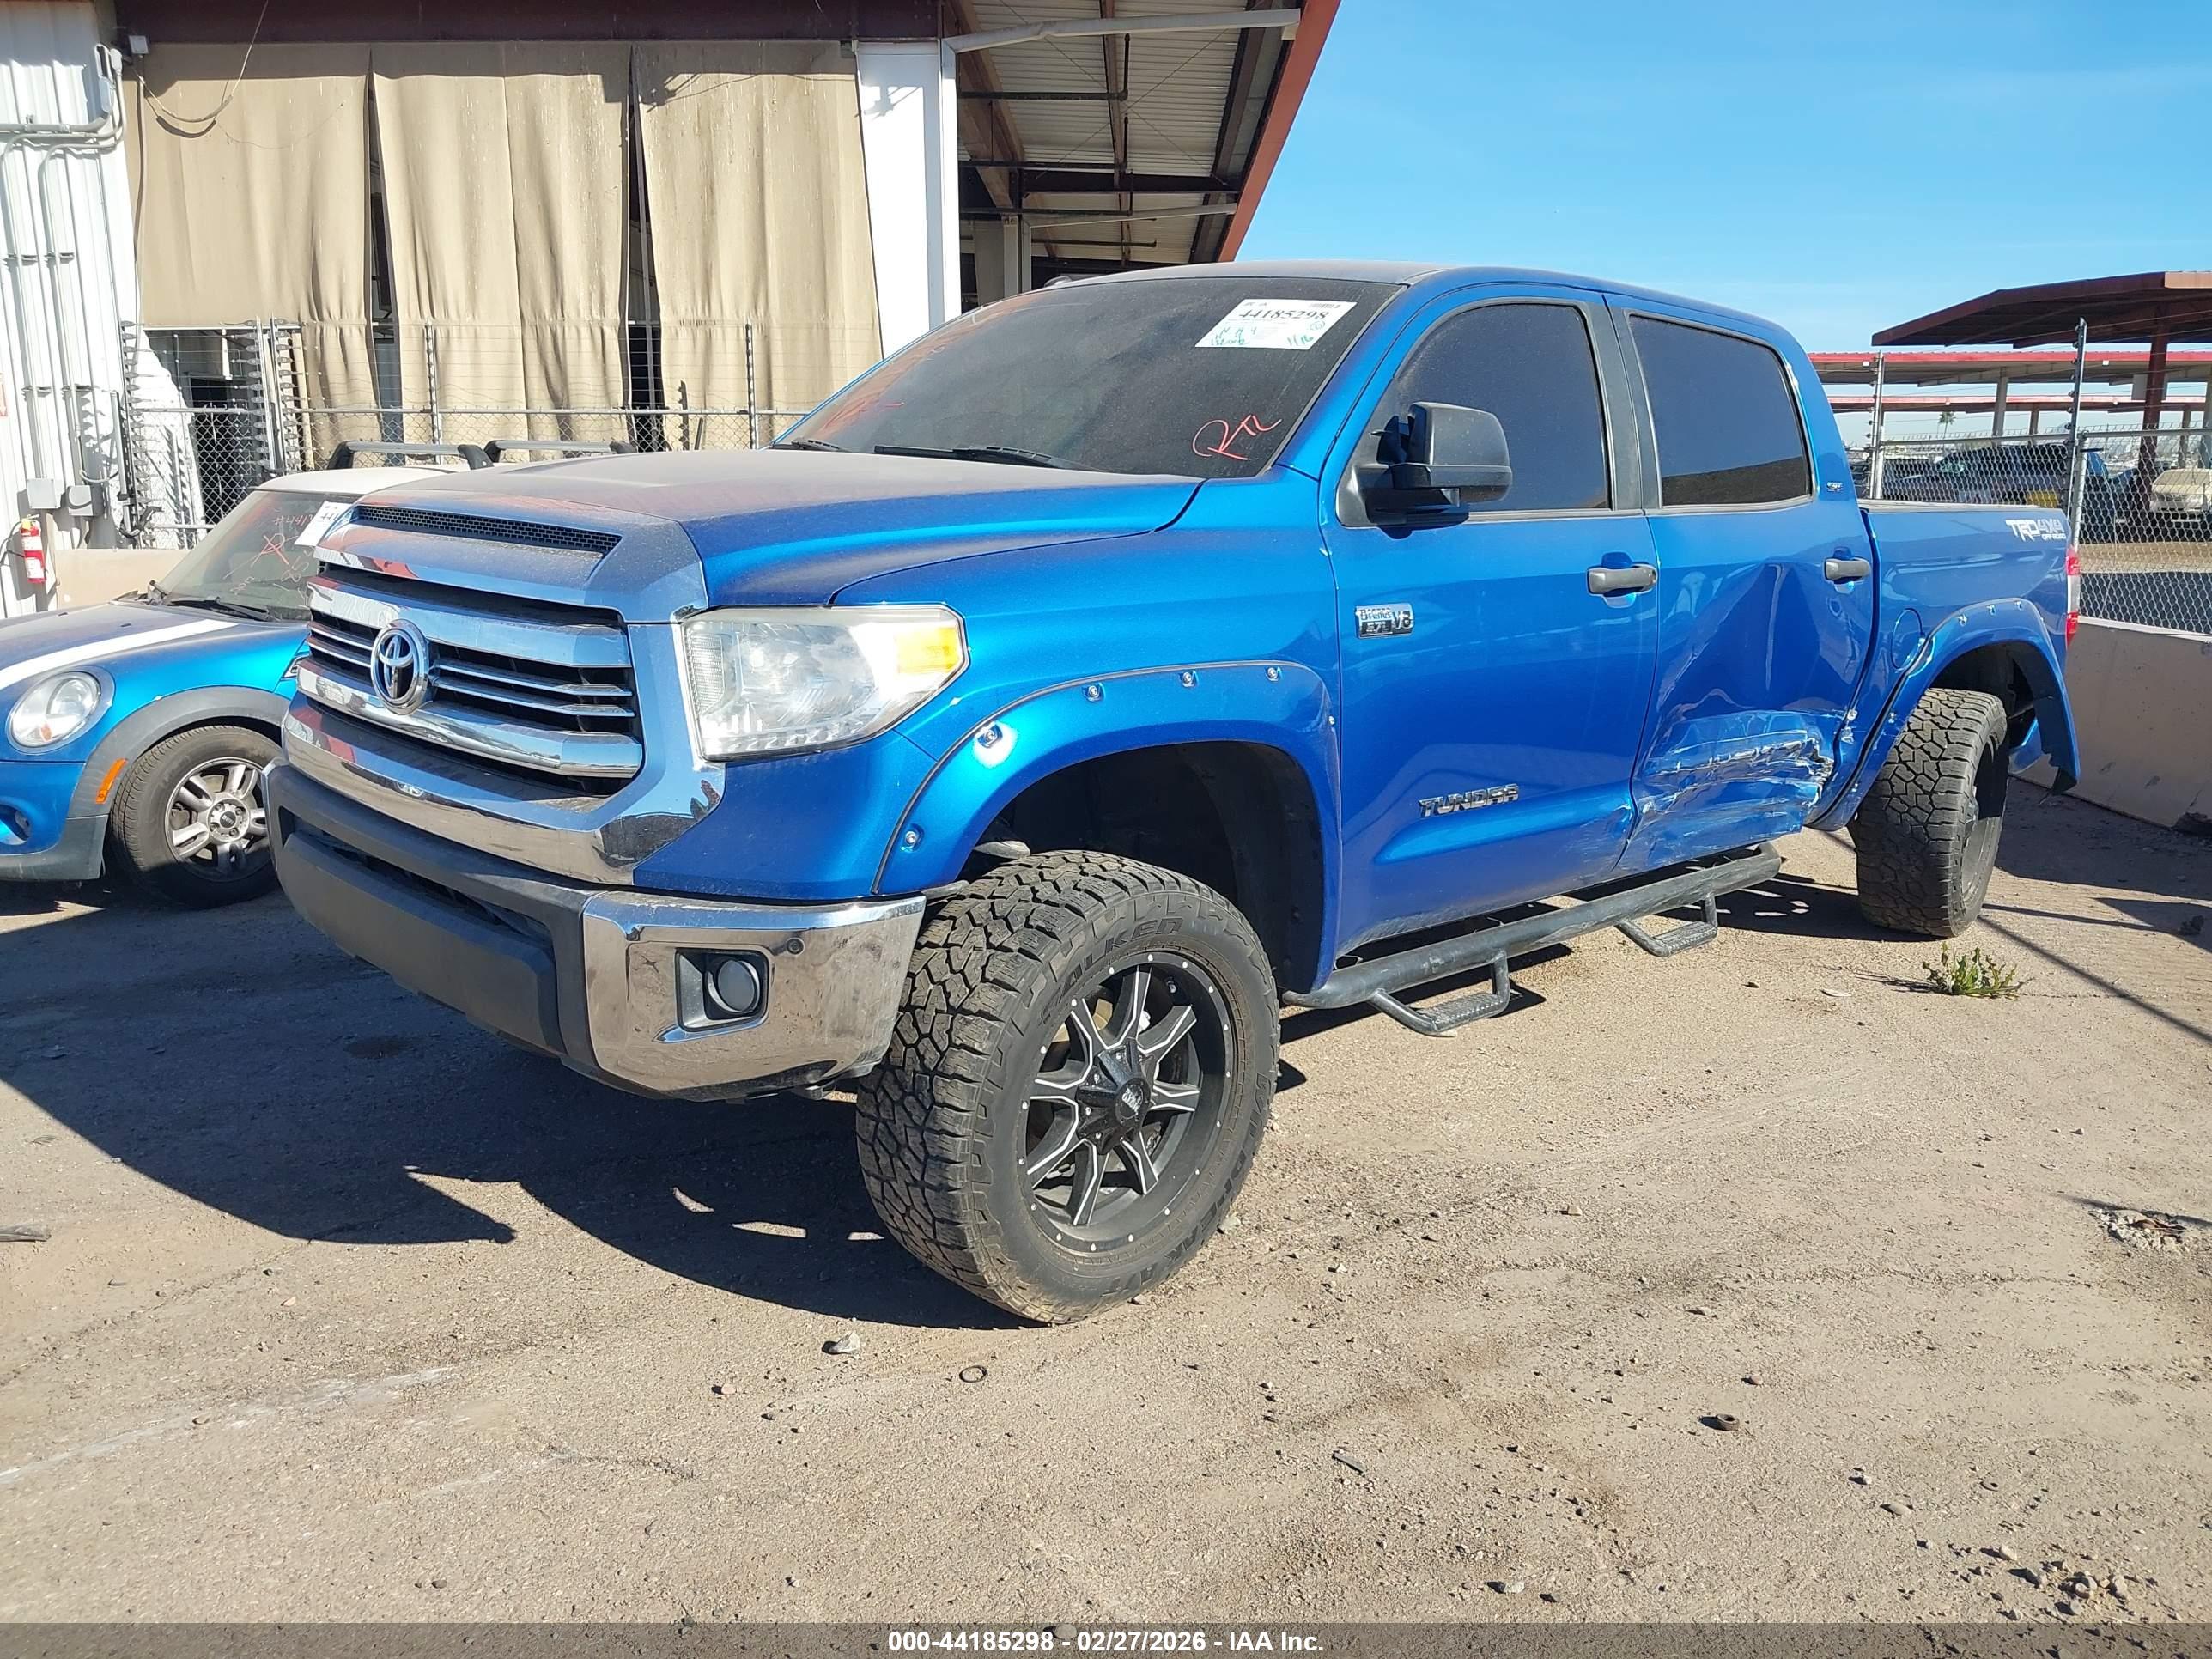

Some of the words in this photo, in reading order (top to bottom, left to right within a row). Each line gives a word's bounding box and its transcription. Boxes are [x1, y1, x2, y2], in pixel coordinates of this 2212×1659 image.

[1239, 309, 1330, 320] 44185298
[2005, 519, 2040, 542] TRD
[1392, 611, 1412, 629] V8
[1419, 783, 1519, 817] TUNDRA
